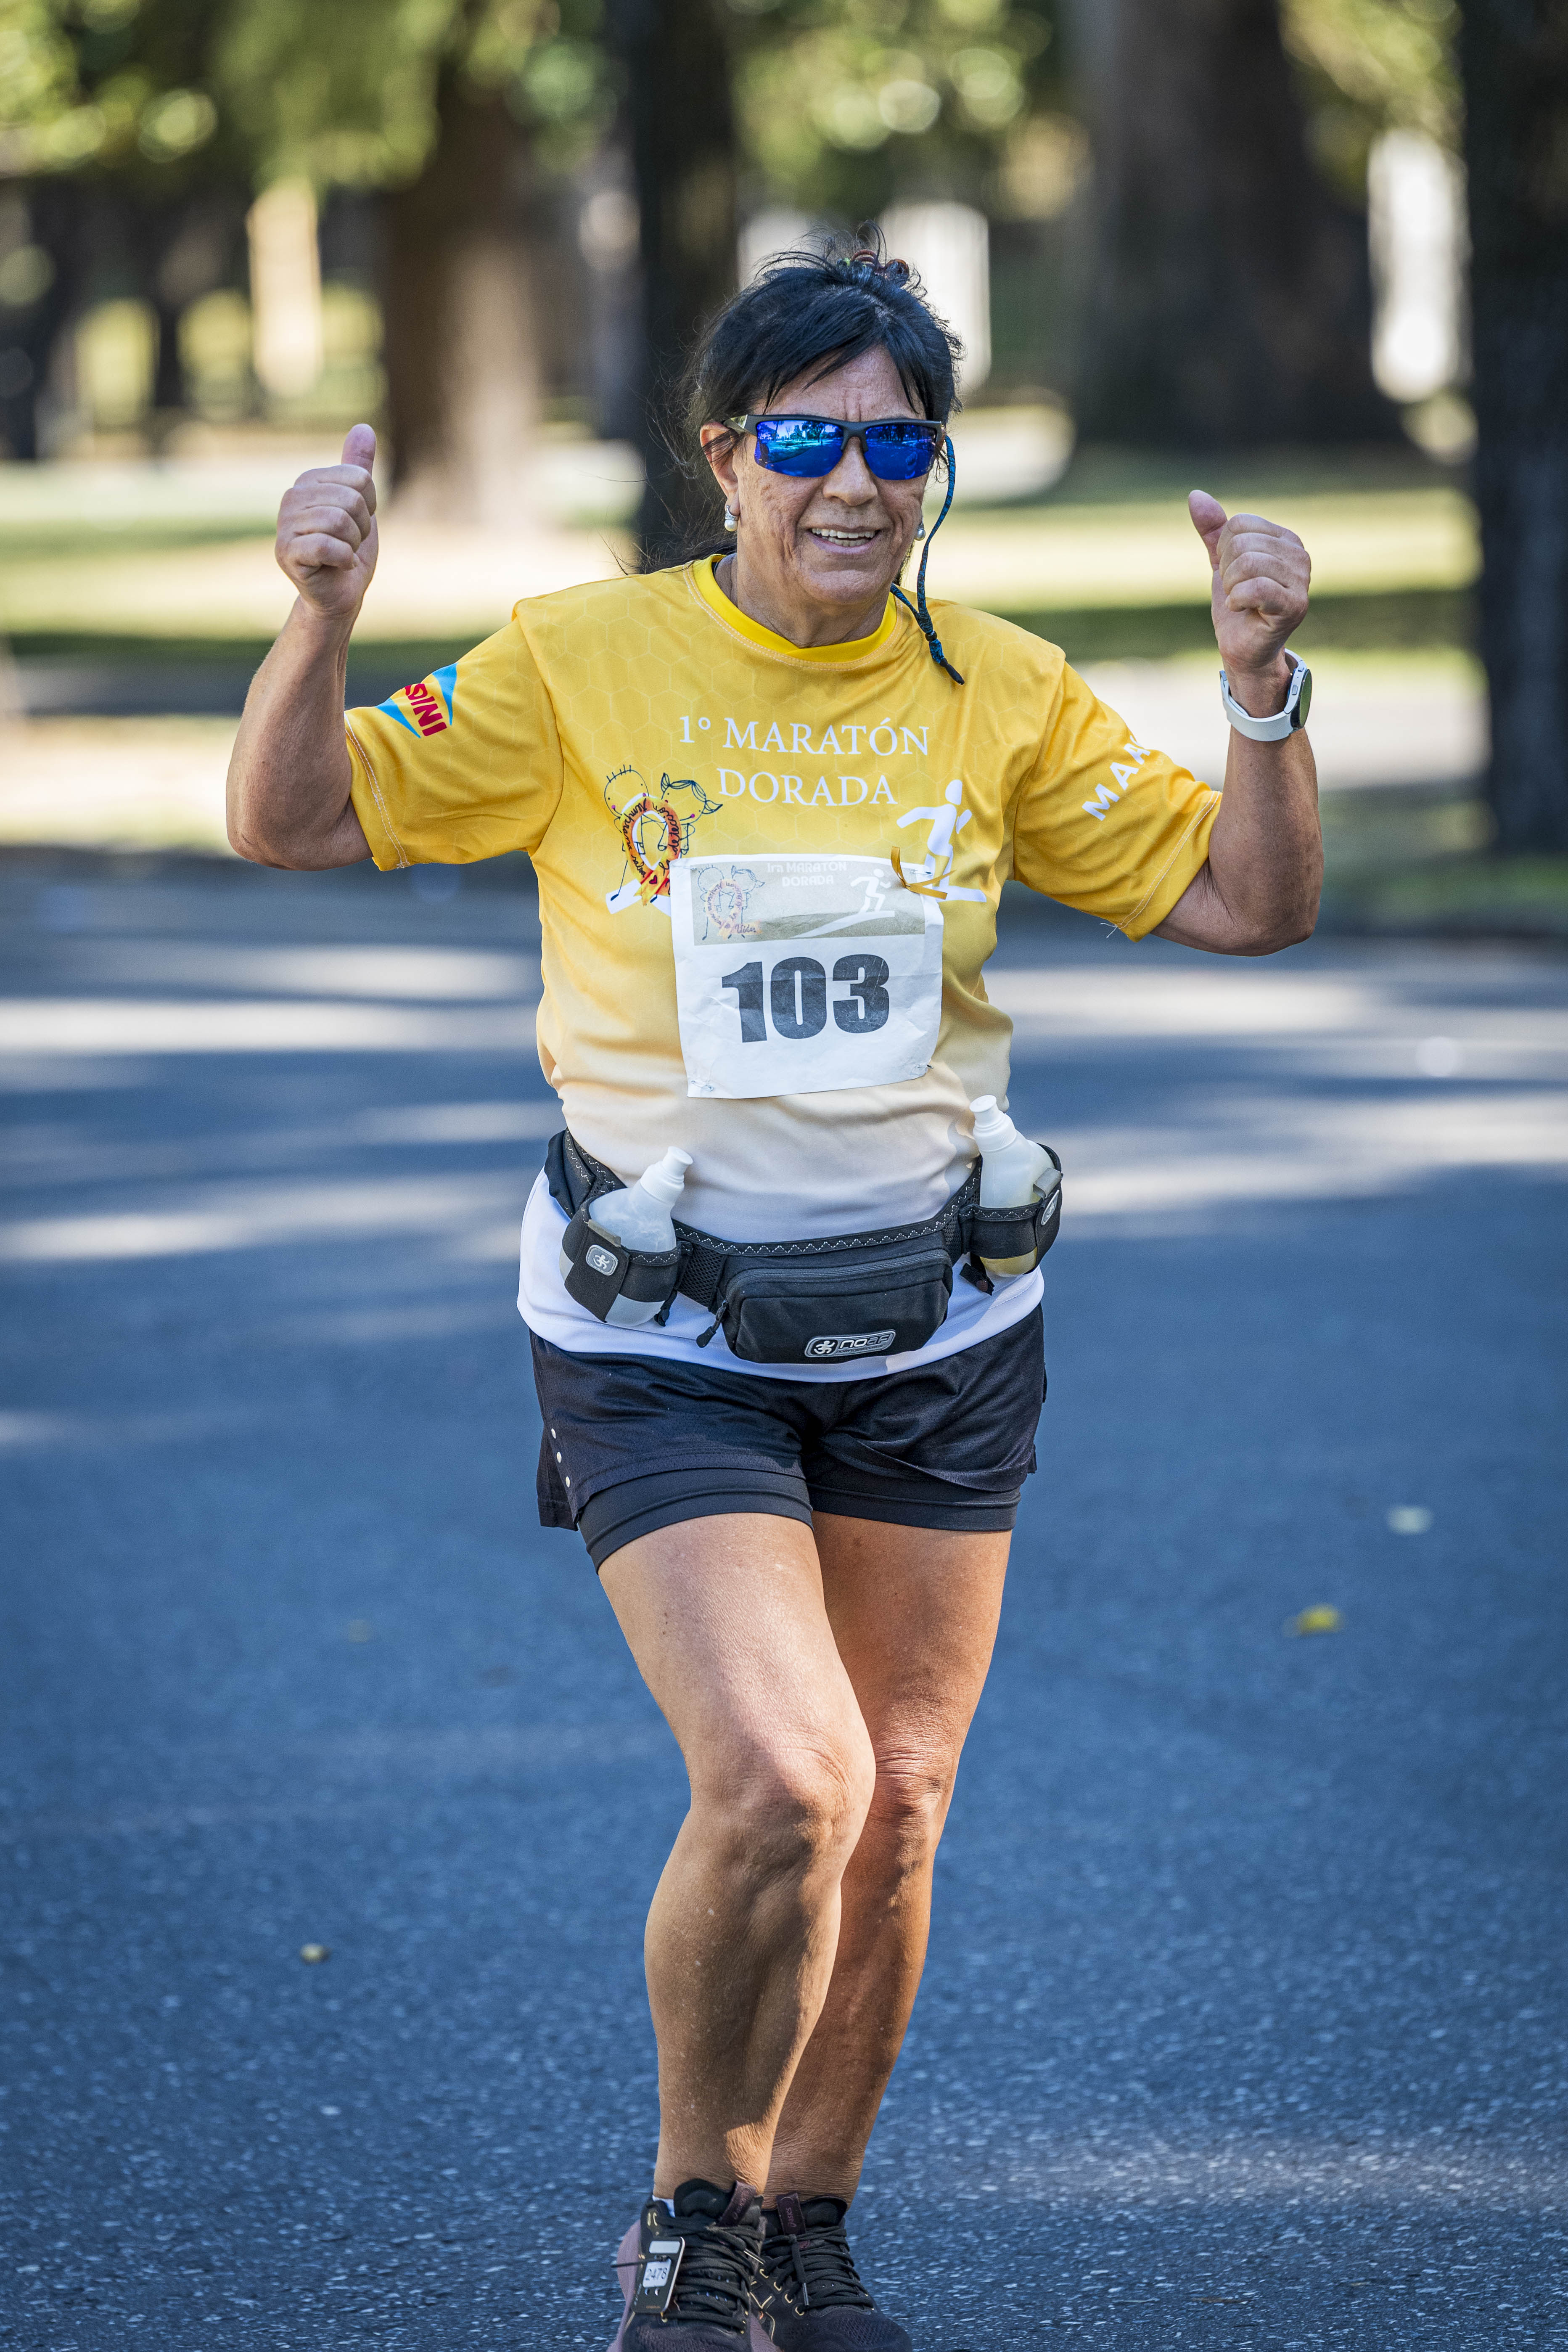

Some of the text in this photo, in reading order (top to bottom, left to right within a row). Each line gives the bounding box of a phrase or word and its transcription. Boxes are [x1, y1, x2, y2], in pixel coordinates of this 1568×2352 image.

[722, 717, 930, 756] MARATÓN
[716, 767, 899, 806] DORADA
[622, 798, 648, 850] temprana
[631, 854, 646, 878] salva
[782, 874, 834, 886] DORADA
[722, 954, 889, 1043] 103
